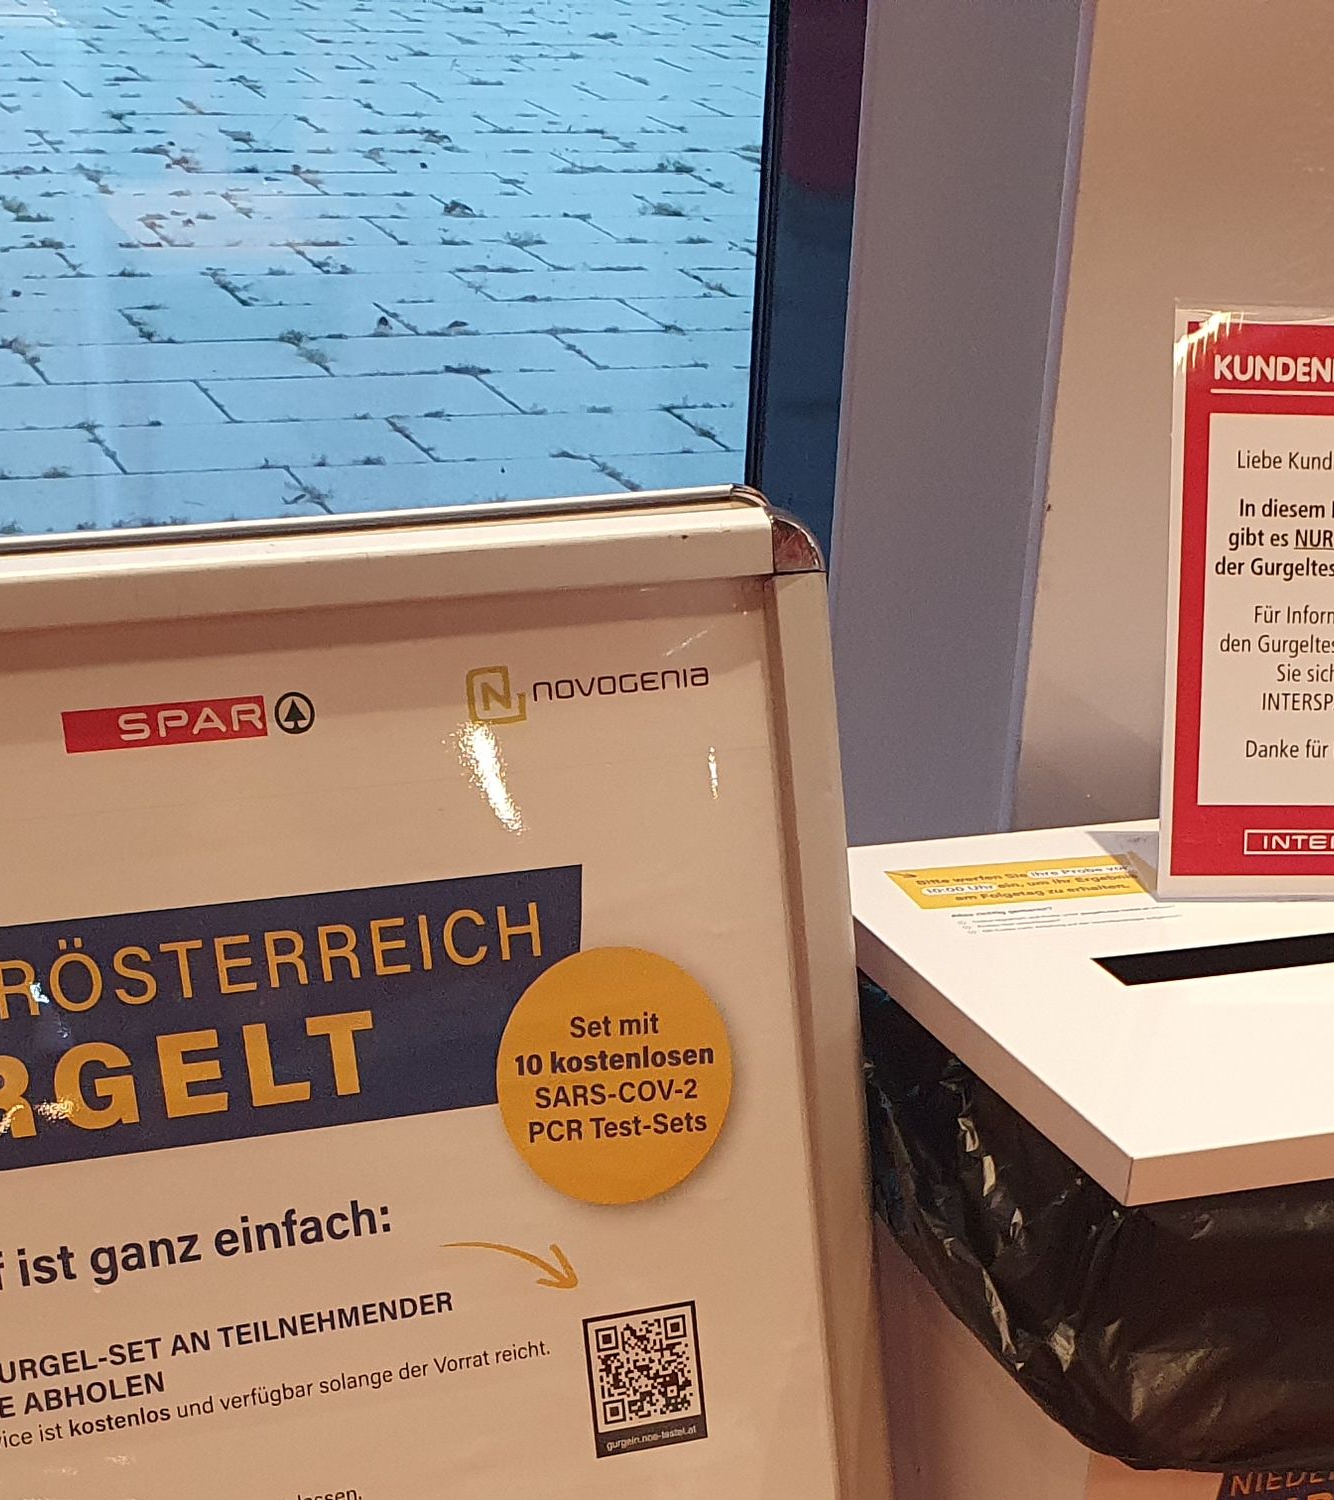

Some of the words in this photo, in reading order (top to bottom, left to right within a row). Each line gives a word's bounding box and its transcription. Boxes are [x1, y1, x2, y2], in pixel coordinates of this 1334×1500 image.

[1238, 450, 1282, 469] Liebe
[1240, 499, 1255, 516] In
[1262, 499, 1324, 517] diesem
[1228, 528, 1264, 551] gibt
[1270, 533, 1289, 548] es
[1294, 531, 1334, 549] NUR
[1215, 557, 1245, 577] der
[1255, 606, 1280, 623] Für
[1221, 634, 1250, 652] den
[1278, 664, 1300, 682] Sie
[118, 702, 264, 741] SPAR
[1246, 740, 1299, 758] Danke
[1306, 739, 1328, 758] für
[570, 1016, 612, 1038] Set
[619, 1011, 660, 1036] mit
[514, 1054, 543, 1076] 10
[550, 1046, 714, 1075] kostenlosen
[535, 1078, 698, 1109] SARS-COV-2
[528, 1119, 583, 1143] PCR
[589, 1112, 708, 1140] Test-Sets
[17, 1246, 76, 1286] ist
[91, 1234, 201, 1285] ganz
[215, 1200, 390, 1256] einfach:
[172, 1330, 210, 1356] AN
[217, 1292, 452, 1347] TEILNEHMENDER
[25, 1372, 164, 1414] ABHOLEN
[39, 1424, 63, 1441] ist
[69, 1408, 170, 1436] kostenlos
[177, 1396, 213, 1418] und
[220, 1383, 312, 1410] verfügbar
[320, 1371, 392, 1393] solange
[399, 1362, 428, 1379] der
[434, 1351, 489, 1373] Vorrat
[496, 1341, 549, 1363] reicht.
